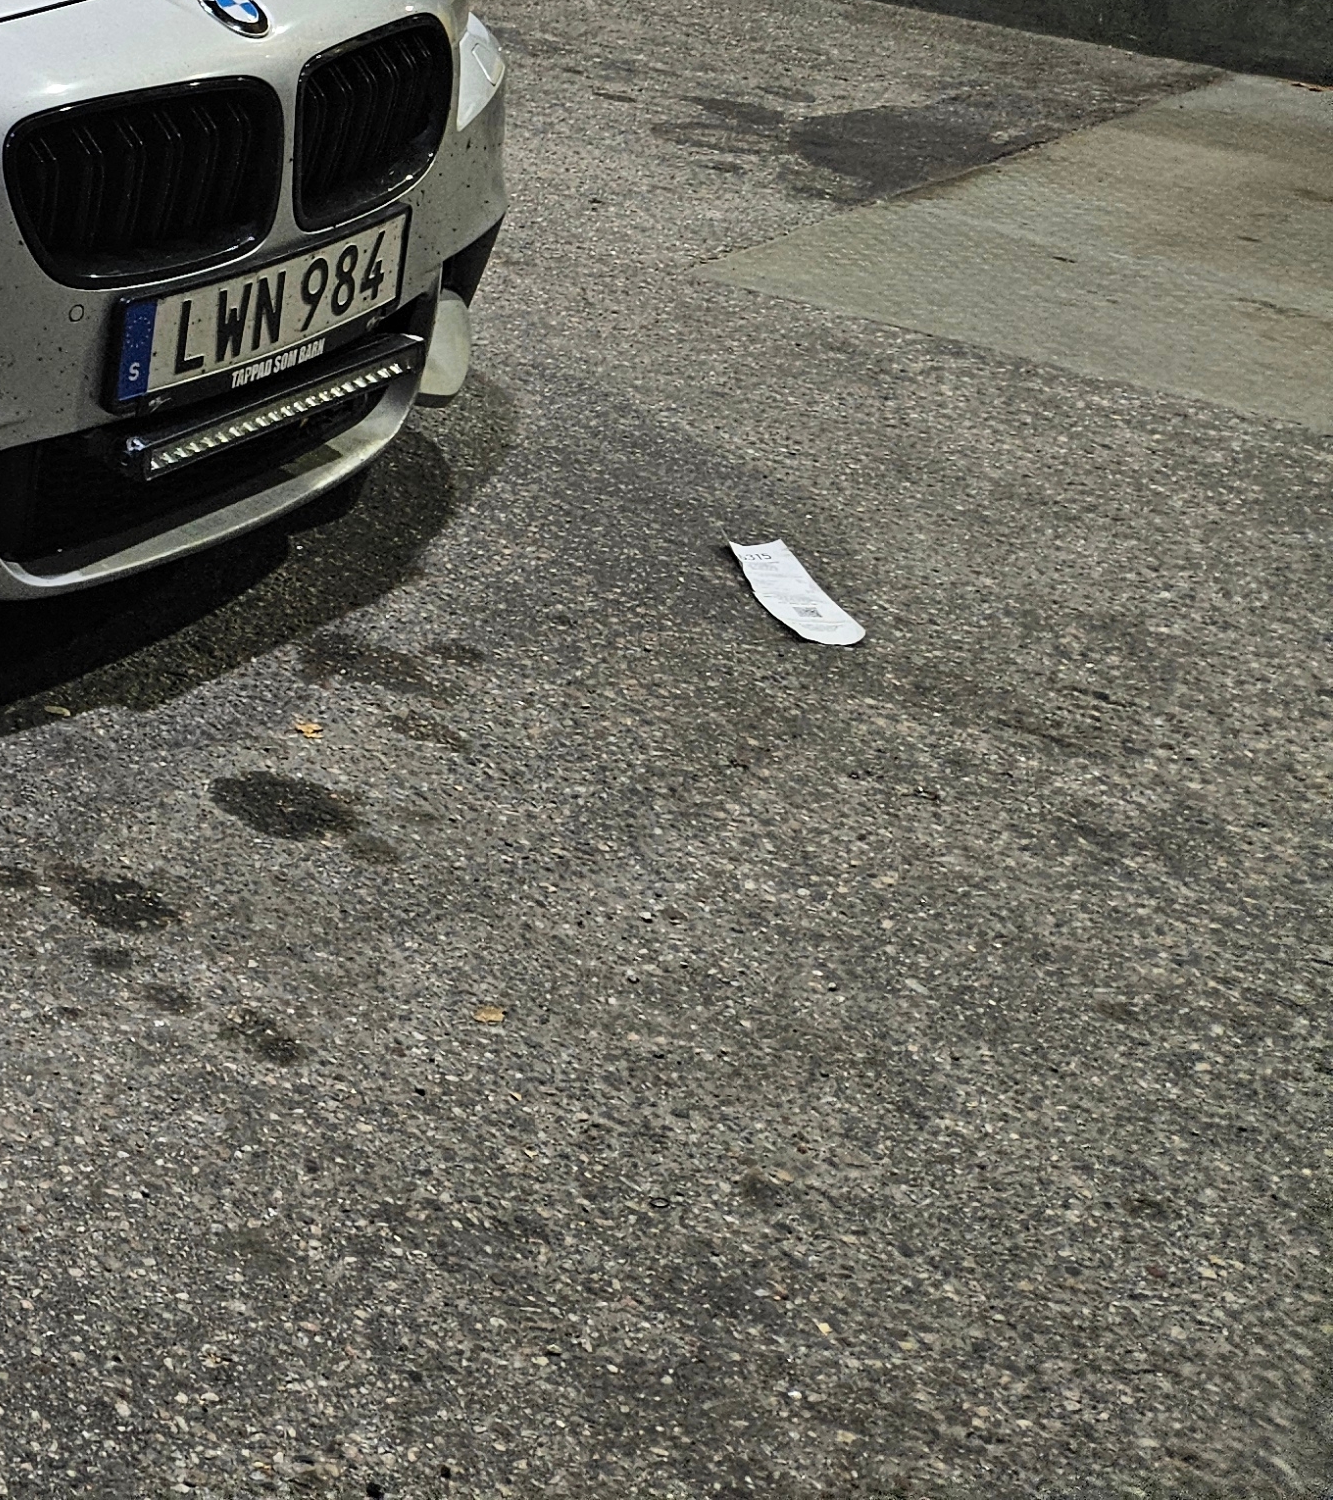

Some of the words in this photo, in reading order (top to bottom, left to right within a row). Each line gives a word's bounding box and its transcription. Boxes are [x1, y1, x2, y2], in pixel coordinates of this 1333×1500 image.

[174, 271, 287, 375] LWN
[300, 230, 386, 332] 984
[128, 362, 139, 381] S
[232, 359, 273, 389] TAPPAD
[273, 349, 298, 373] SOM
[298, 338, 325, 364] BARN
